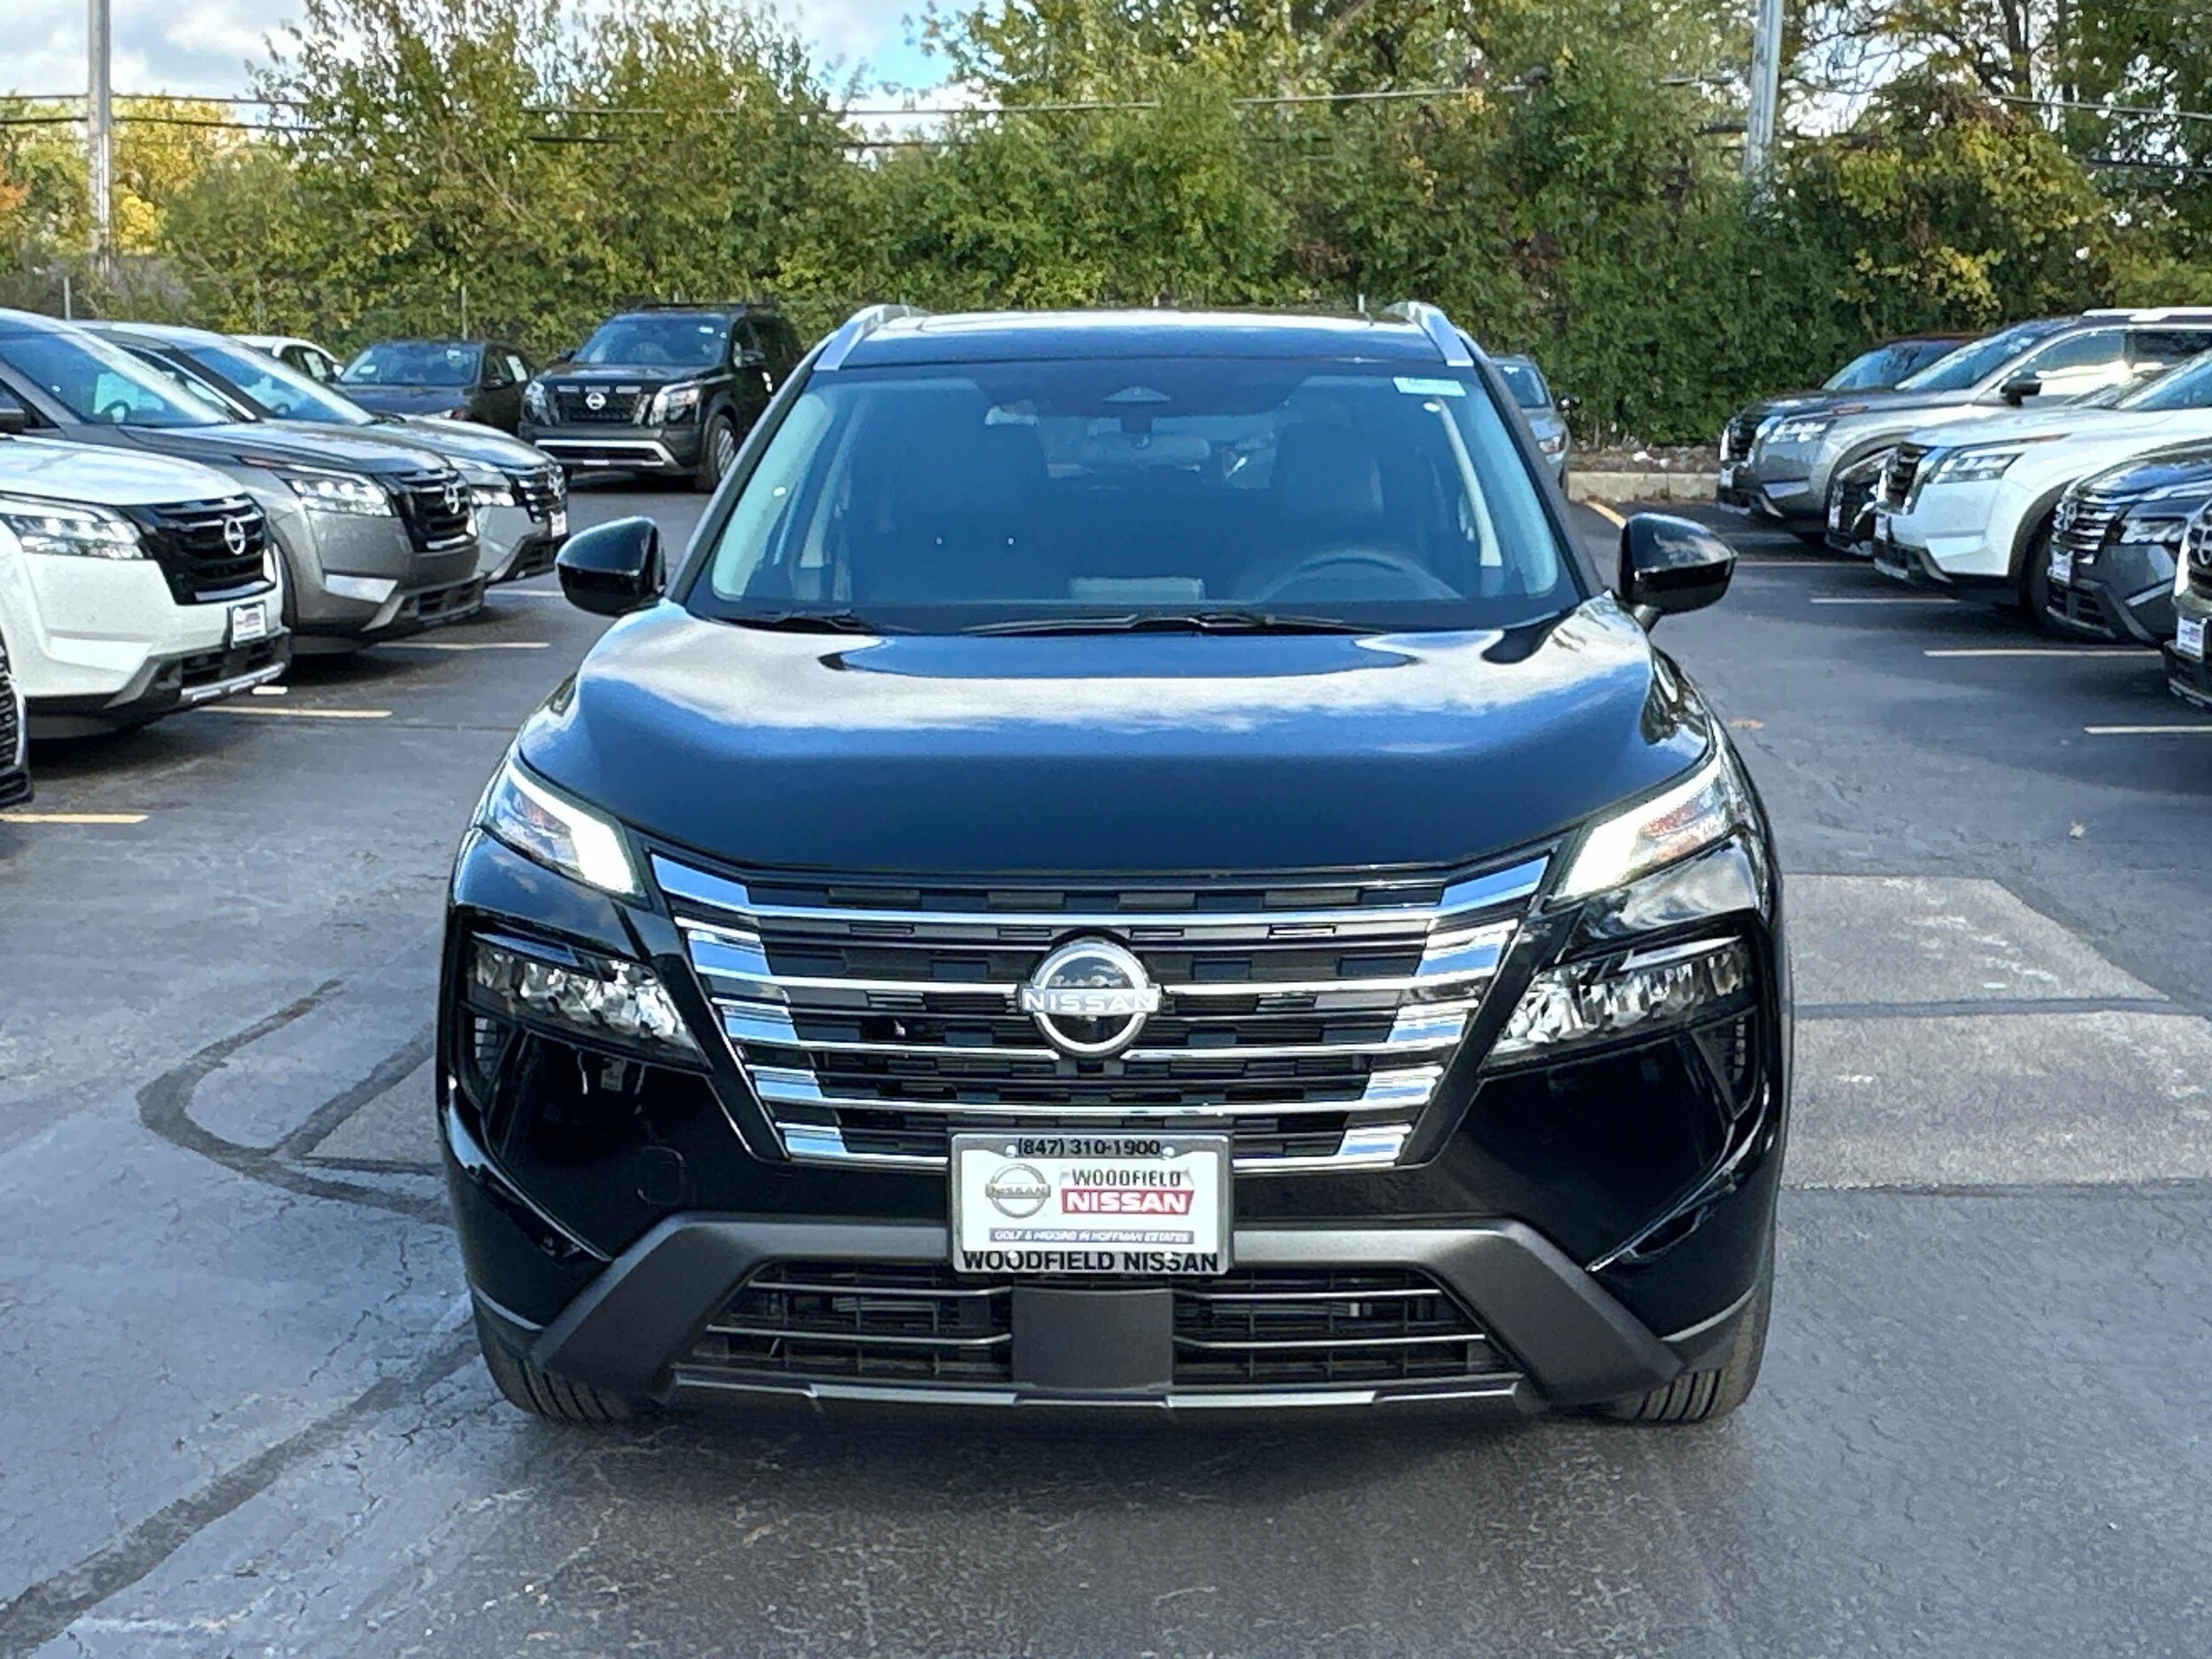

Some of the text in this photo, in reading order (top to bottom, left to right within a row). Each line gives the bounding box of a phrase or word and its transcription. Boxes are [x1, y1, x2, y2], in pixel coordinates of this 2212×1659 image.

[1022, 990, 1160, 1012] NISSAN
[1018, 1138, 1161, 1156] (847) 310-1900
[1072, 1169, 1180, 1187] WOODFIELD
[1067, 1191, 1187, 1212] NISSAN
[963, 1250, 1217, 1271] WOODFIELD NISSAN
